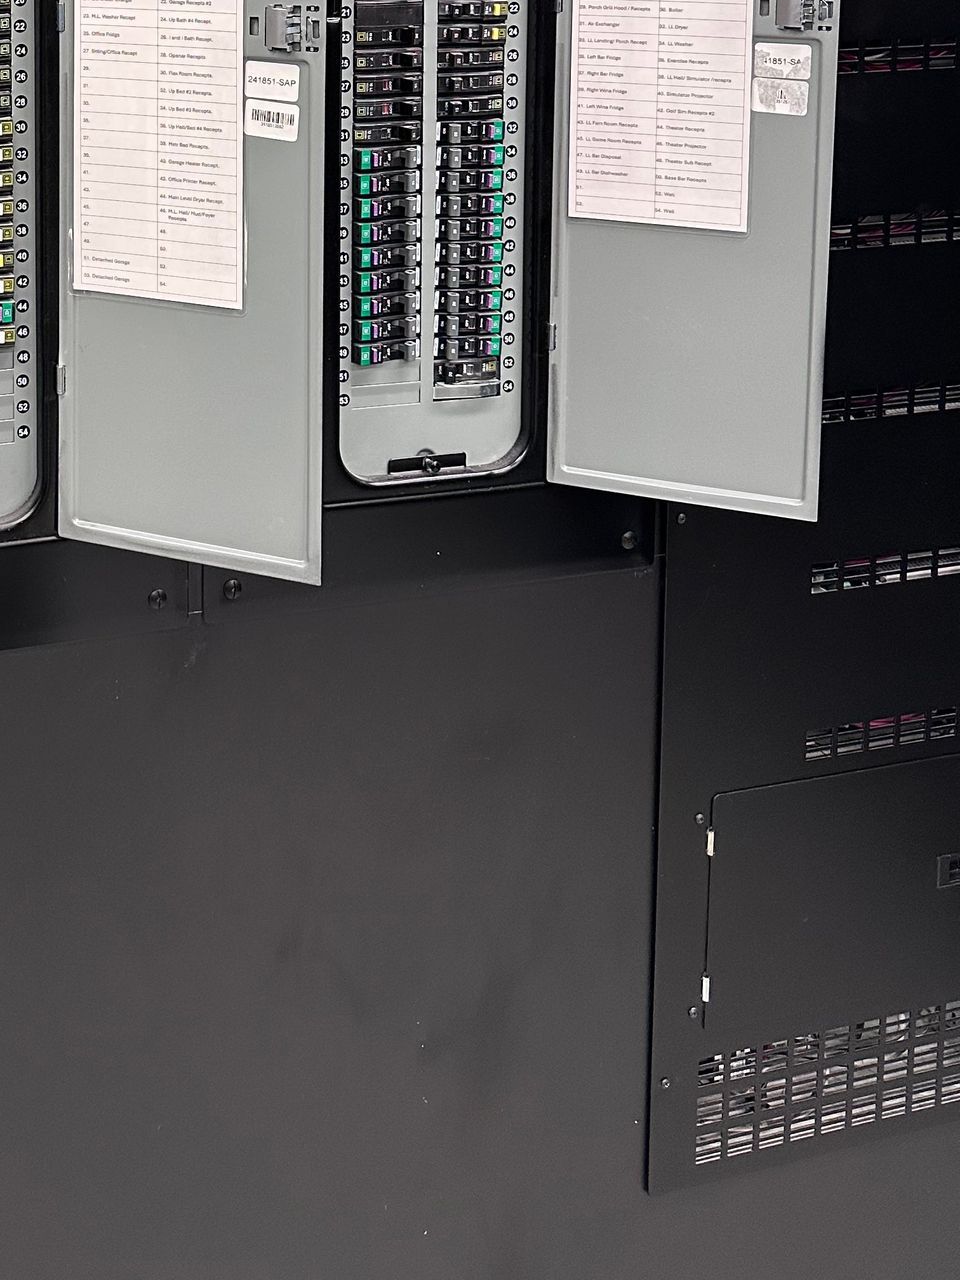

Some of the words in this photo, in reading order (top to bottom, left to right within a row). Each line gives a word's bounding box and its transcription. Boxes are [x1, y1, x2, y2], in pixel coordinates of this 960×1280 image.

[16, 46, 26, 55] 24
[248, 76, 296, 87] 241851-SAP
[508, 124, 517, 132] 32
[505, 219, 515, 227] 40
[17, 302, 27, 311] 44
[504, 358, 513, 367] 52
[17, 377, 27, 386] 50
